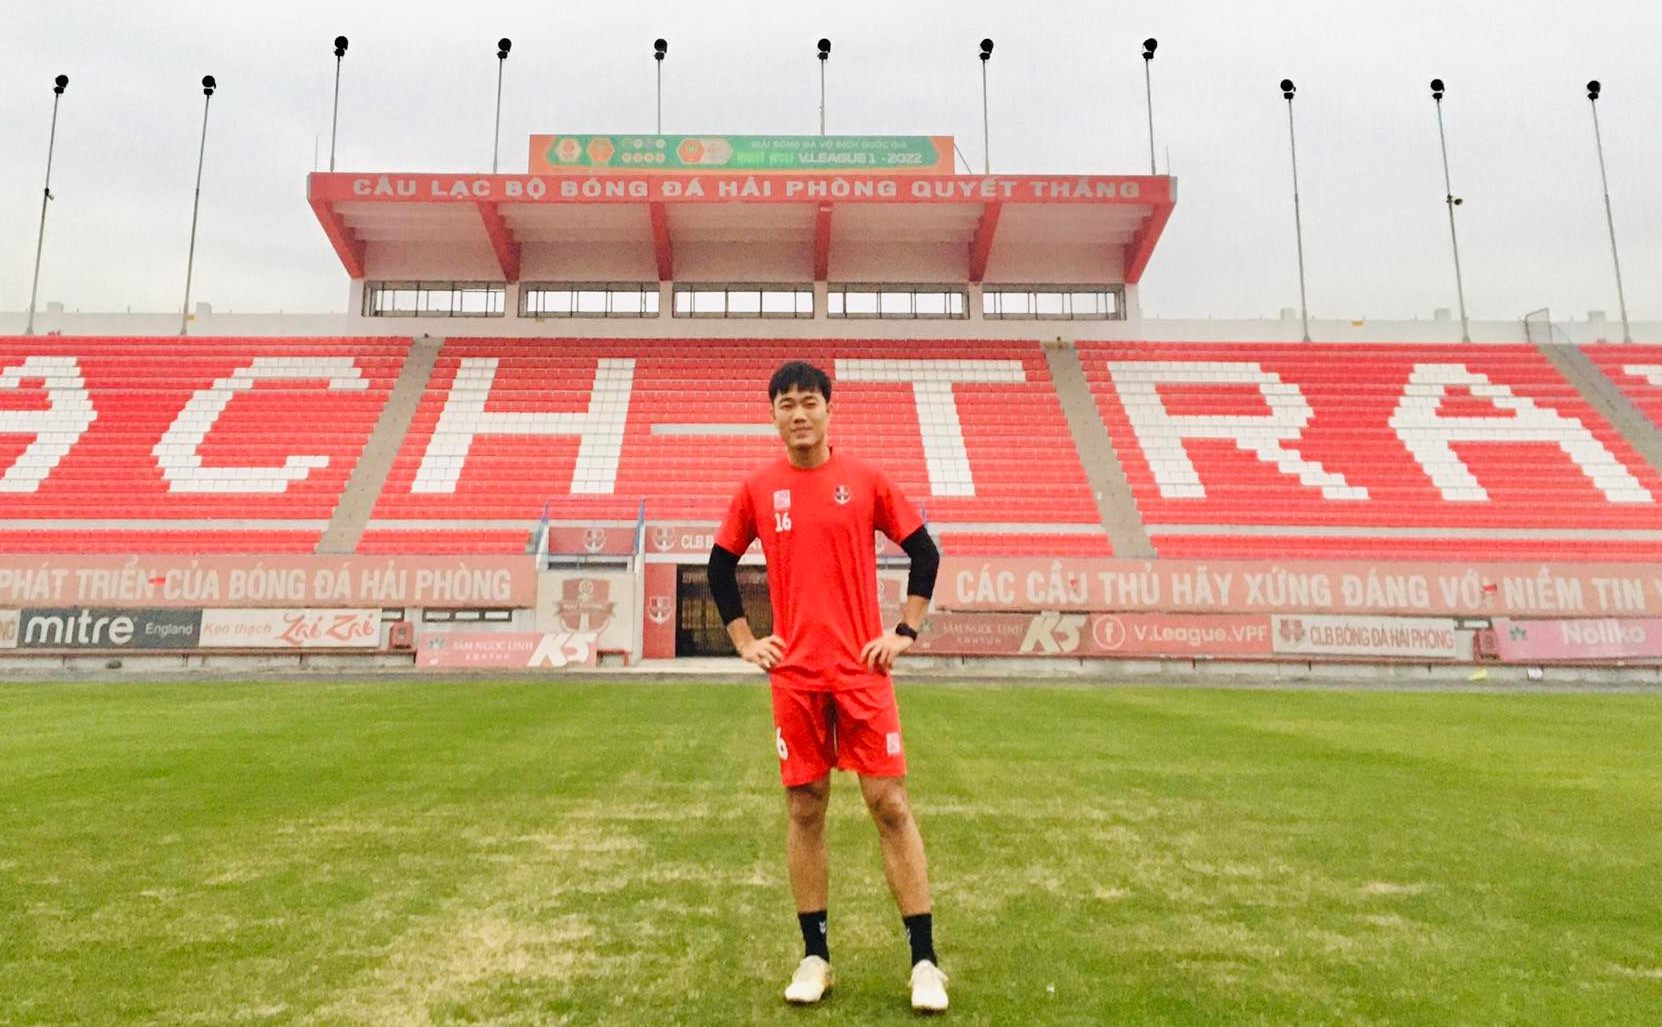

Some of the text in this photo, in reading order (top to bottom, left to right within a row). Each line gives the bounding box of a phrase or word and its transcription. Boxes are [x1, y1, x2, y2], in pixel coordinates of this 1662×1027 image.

[888, 153, 922, 164] 2022
[353, 176, 1140, 200] CÂU LẠC BỘ BÓNG ĐÁ HẢI PHÒNG QUYẾT THẮNG
[774, 512, 791, 532] 16
[681, 535, 704, 548] CLB
[0, 555, 512, 600] PHÁT TRIỂN CỦA BÓNG ĐÁ HẢI PHÒNG
[956, 563, 1015, 604] CÁC
[1099, 562, 1160, 606] THỦ
[1172, 566, 1233, 606] HÃY
[1244, 566, 1332, 608] XỨNG
[1342, 568, 1431, 609] ĐÁNG
[1592, 577, 1645, 610] TIN
[24, 610, 134, 644] mitre
[145, 623, 193, 637] England
[1018, 612, 1088, 654] K5
[1310, 625, 1334, 645] CLB
[1336, 623, 1370, 647] BÓNG
